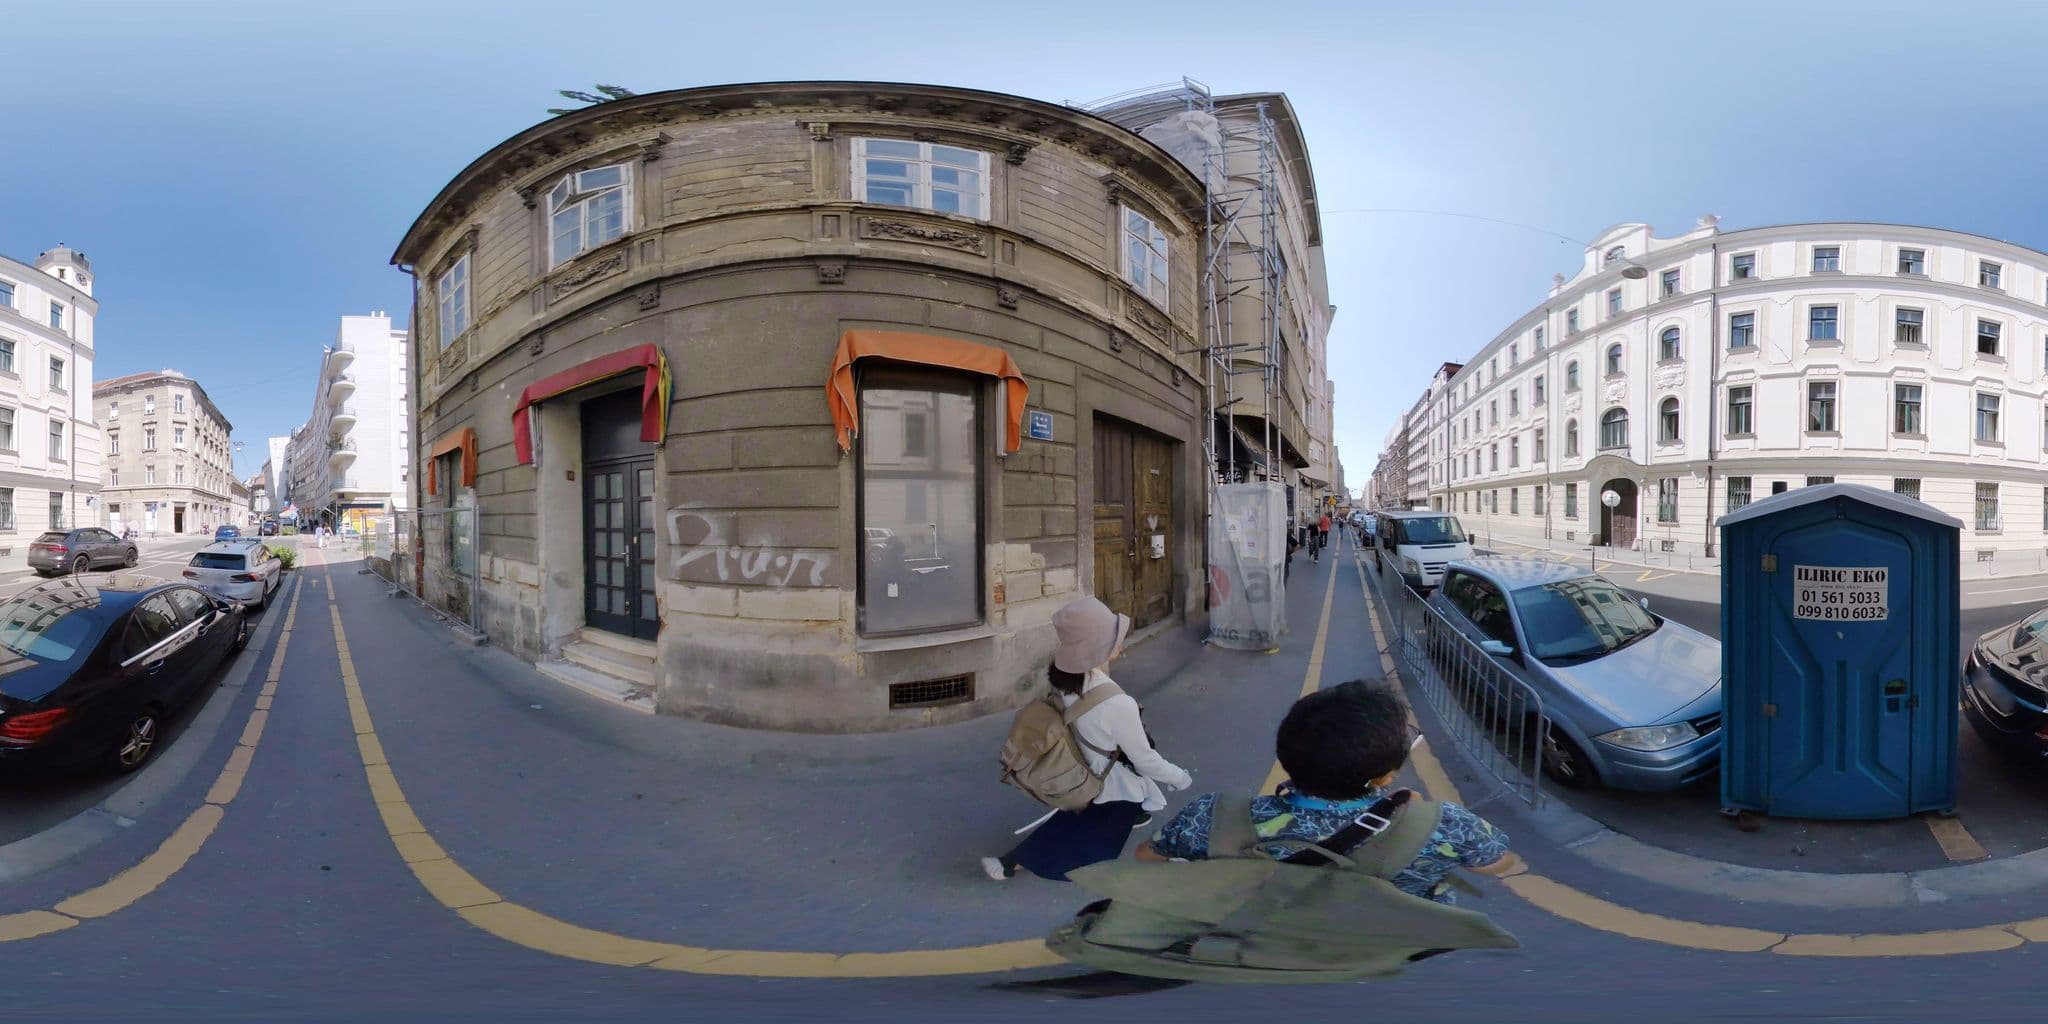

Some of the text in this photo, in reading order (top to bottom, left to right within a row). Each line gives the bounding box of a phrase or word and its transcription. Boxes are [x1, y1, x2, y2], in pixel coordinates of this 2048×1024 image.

[1797, 568, 1886, 583] ILIRIC EKO
[1802, 590, 1880, 604] 01 561 5033
[1798, 605, 1884, 619] 099 810 6032
